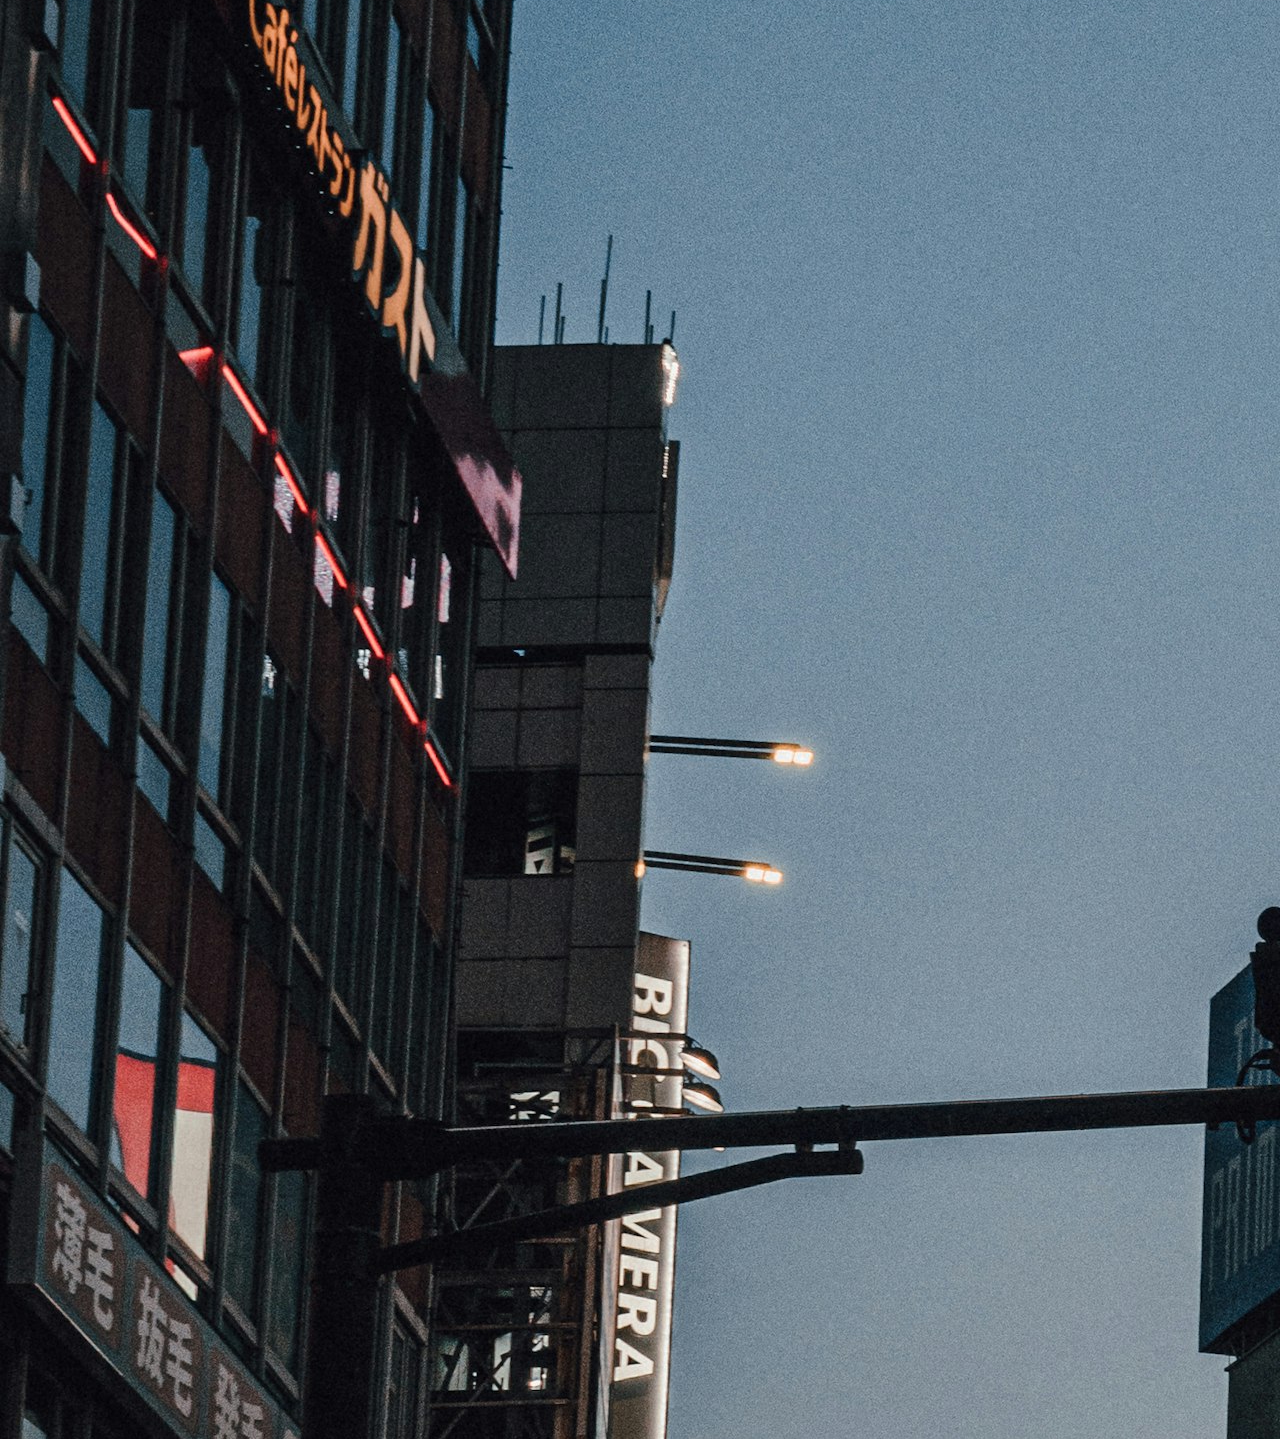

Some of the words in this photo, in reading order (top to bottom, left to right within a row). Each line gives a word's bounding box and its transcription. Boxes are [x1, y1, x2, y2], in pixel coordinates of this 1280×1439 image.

[352, 161, 436, 383] ガスト
[612, 1112, 667, 1383] AMERA
